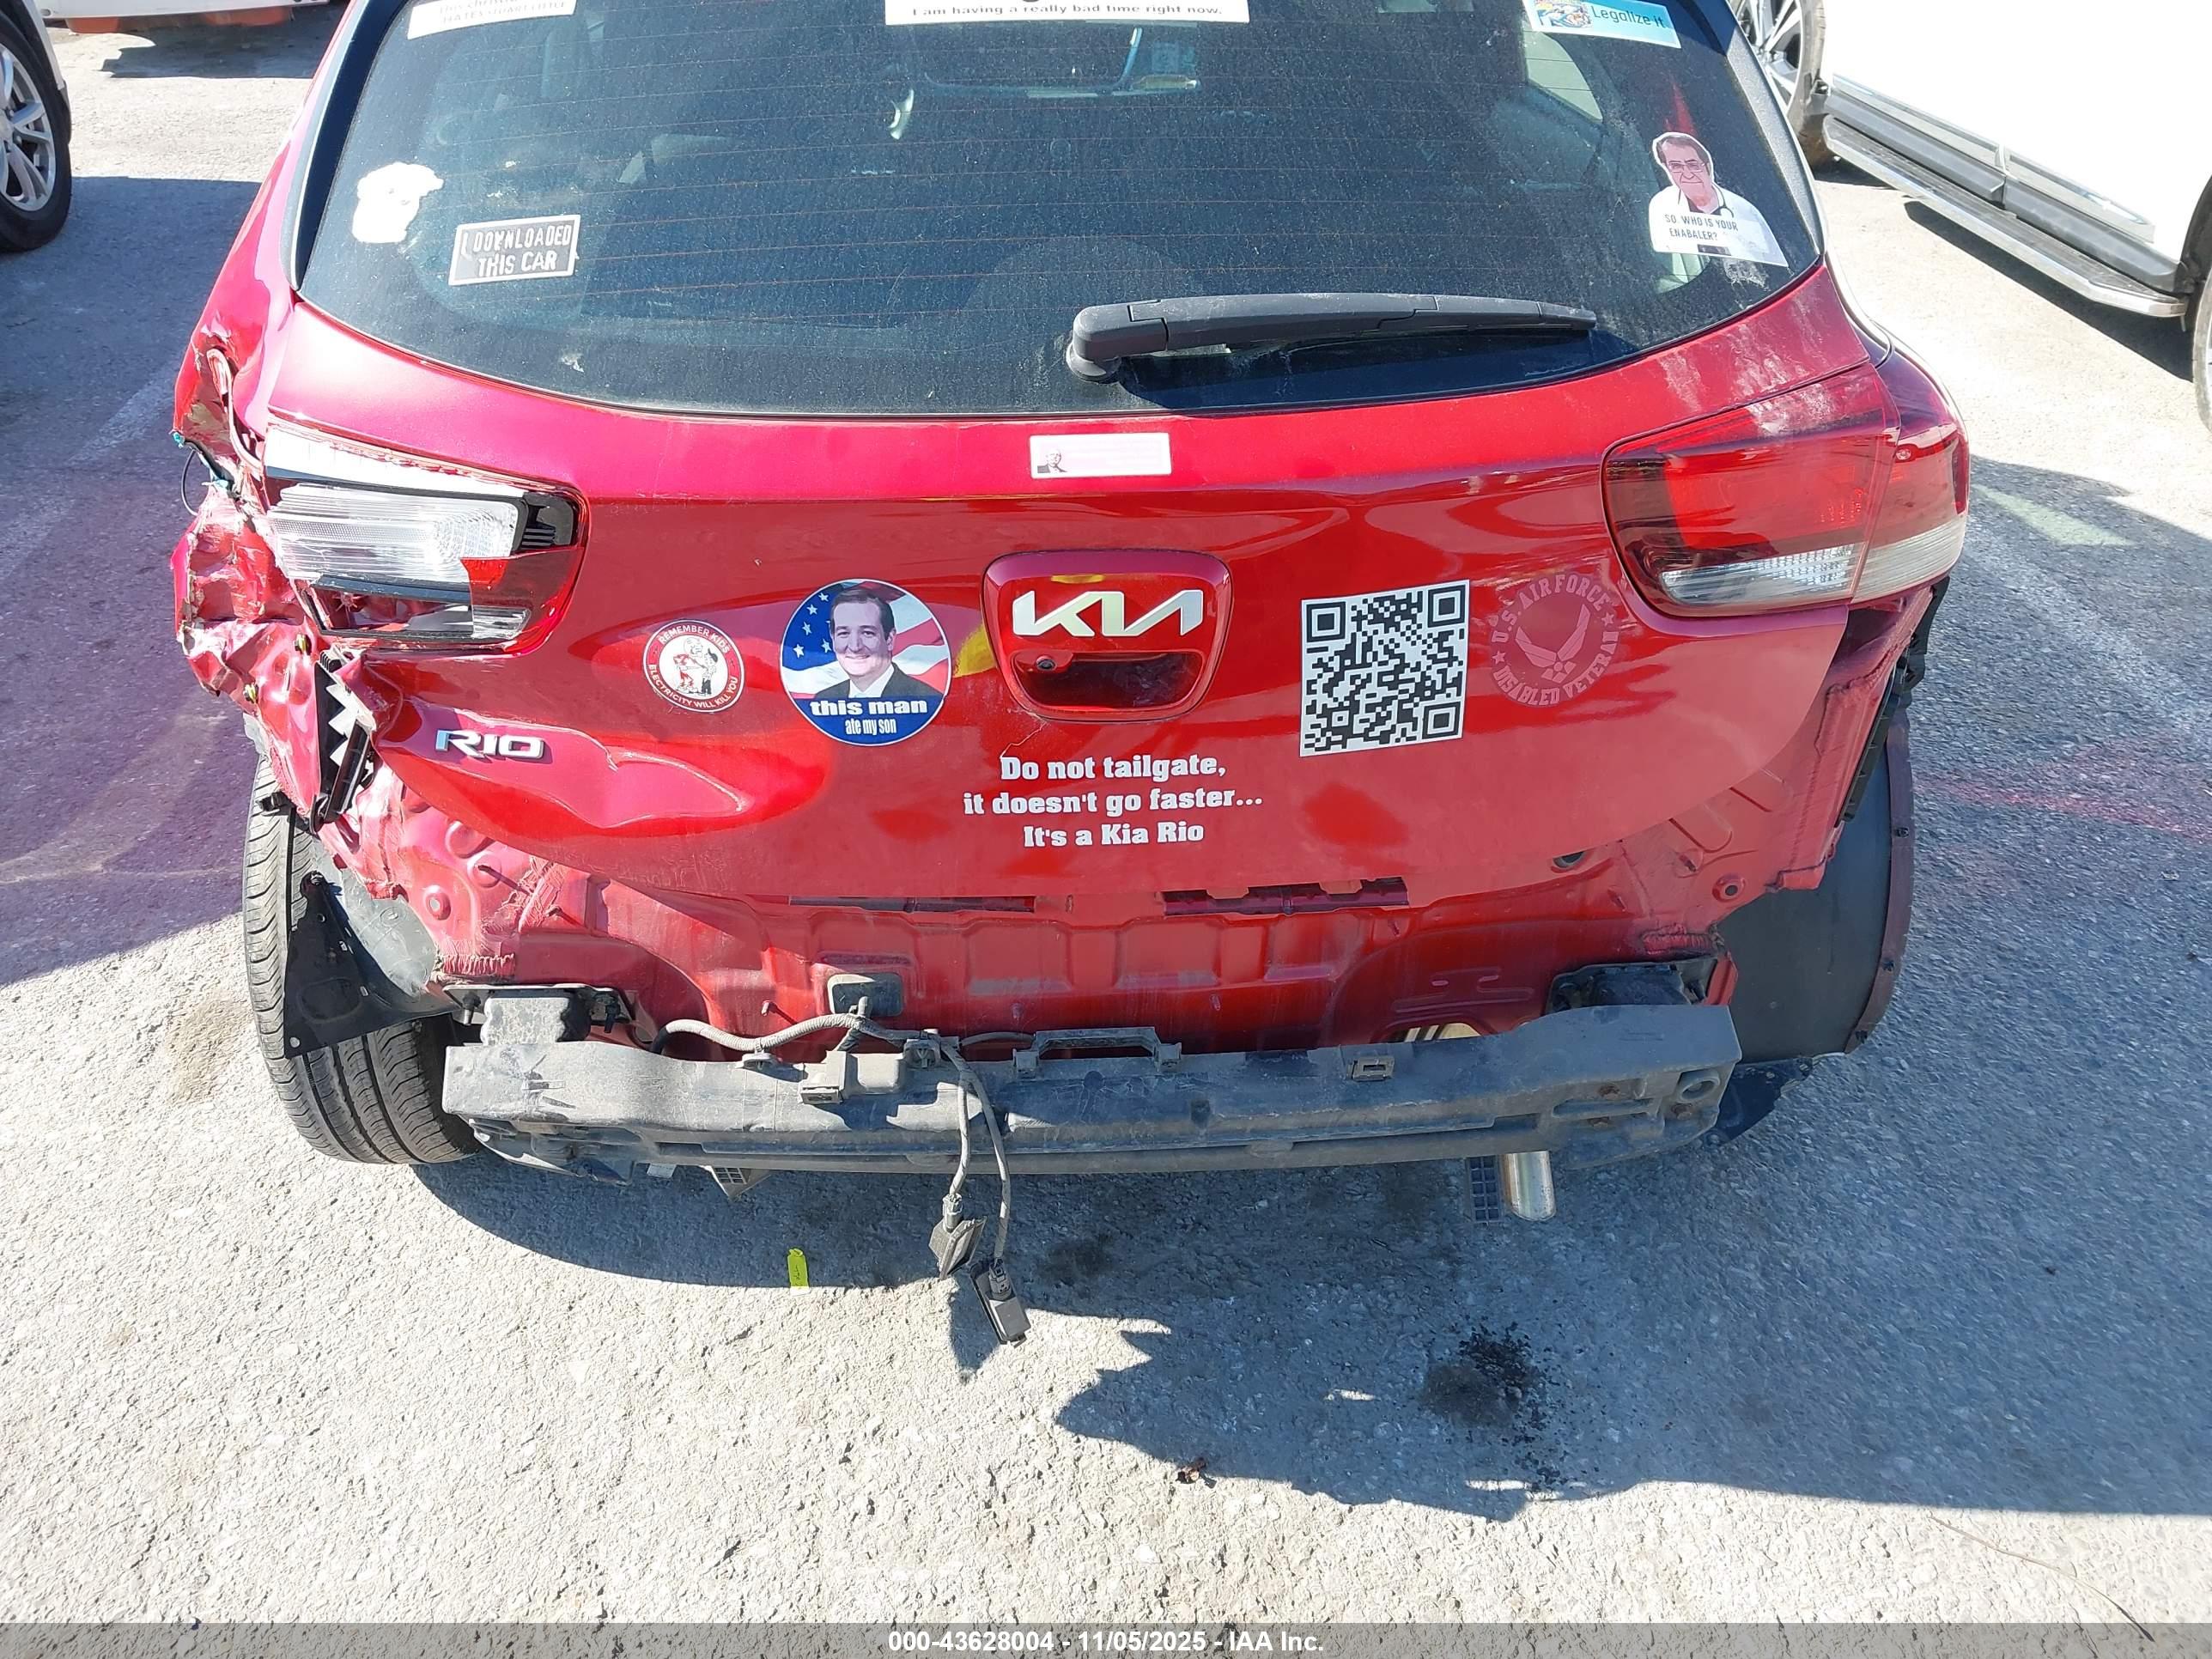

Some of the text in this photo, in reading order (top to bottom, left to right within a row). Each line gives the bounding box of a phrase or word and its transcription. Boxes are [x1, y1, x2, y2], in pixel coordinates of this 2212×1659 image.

[952, 6, 1004, 15] having
[1023, 4, 1067, 14] really
[1146, 5, 1182, 15] right
[1188, 6, 1223, 15] now.
[1590, 5, 1667, 28] Legalize it
[472, 224, 573, 252] DOWNLOADED
[1669, 228, 1717, 241] ENABALER?
[1681, 216, 1703, 227] WHO
[1704, 217, 1714, 228] IS
[1716, 219, 1739, 232] YOUR
[477, 250, 558, 277] THIS CAR
[1518, 577, 1553, 611] AIR
[1553, 574, 1612, 611] FORCE
[1012, 589, 1204, 637] KIA
[657, 624, 731, 653] REMEMBER KIDS
[1492, 630, 1620, 706] DISABLED VETERAN
[647, 664, 693, 706] ELECTRICITY
[714, 694, 732, 707] KILL
[727, 676, 738, 695] YOU
[810, 699, 928, 716] this man
[845, 717, 897, 736] ate my son
[435, 729, 544, 759] RIO
[1000, 754, 1226, 783] Do not tailgate,
[963, 787, 1263, 817] it doesn't go faster...
[1023, 820, 1205, 848] It's a Kia Rio
